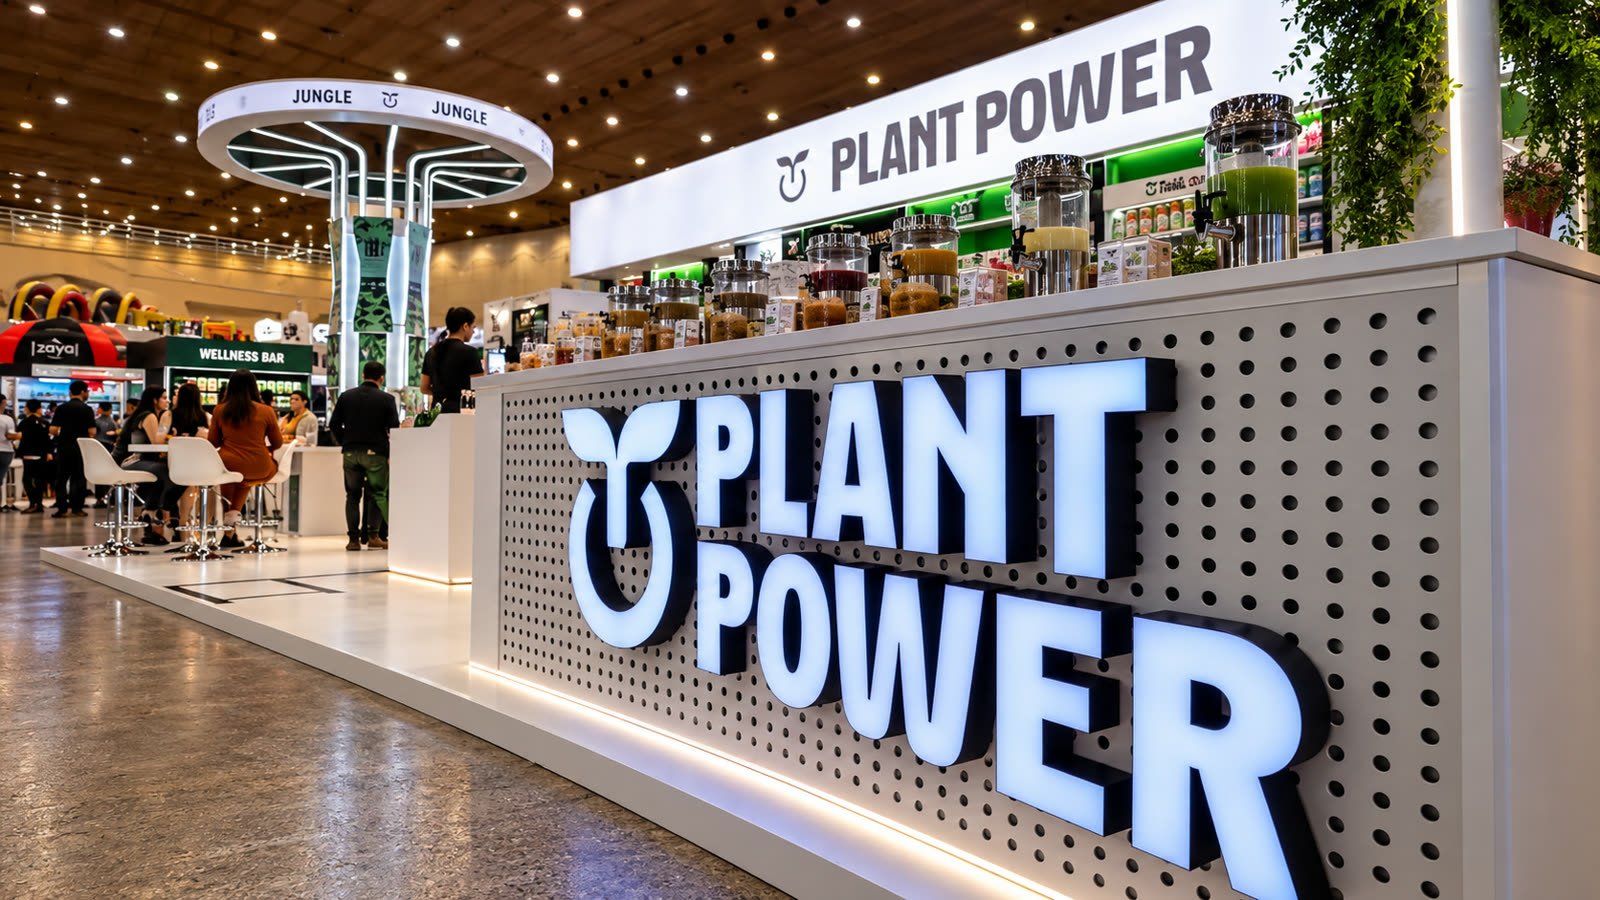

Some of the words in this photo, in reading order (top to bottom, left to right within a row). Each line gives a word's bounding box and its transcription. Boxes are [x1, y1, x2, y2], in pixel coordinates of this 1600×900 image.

[292, 89, 352, 104] JUNGLE
[432, 101, 488, 126] JUNGLE
[831, 101, 964, 192] PLANT
[975, 25, 1213, 155] POWER
[199, 348, 259, 362] WELLNESS
[261, 352, 285, 364] BAR
[697, 357, 1150, 579] PLANT
[697, 541, 1305, 900] POWER
